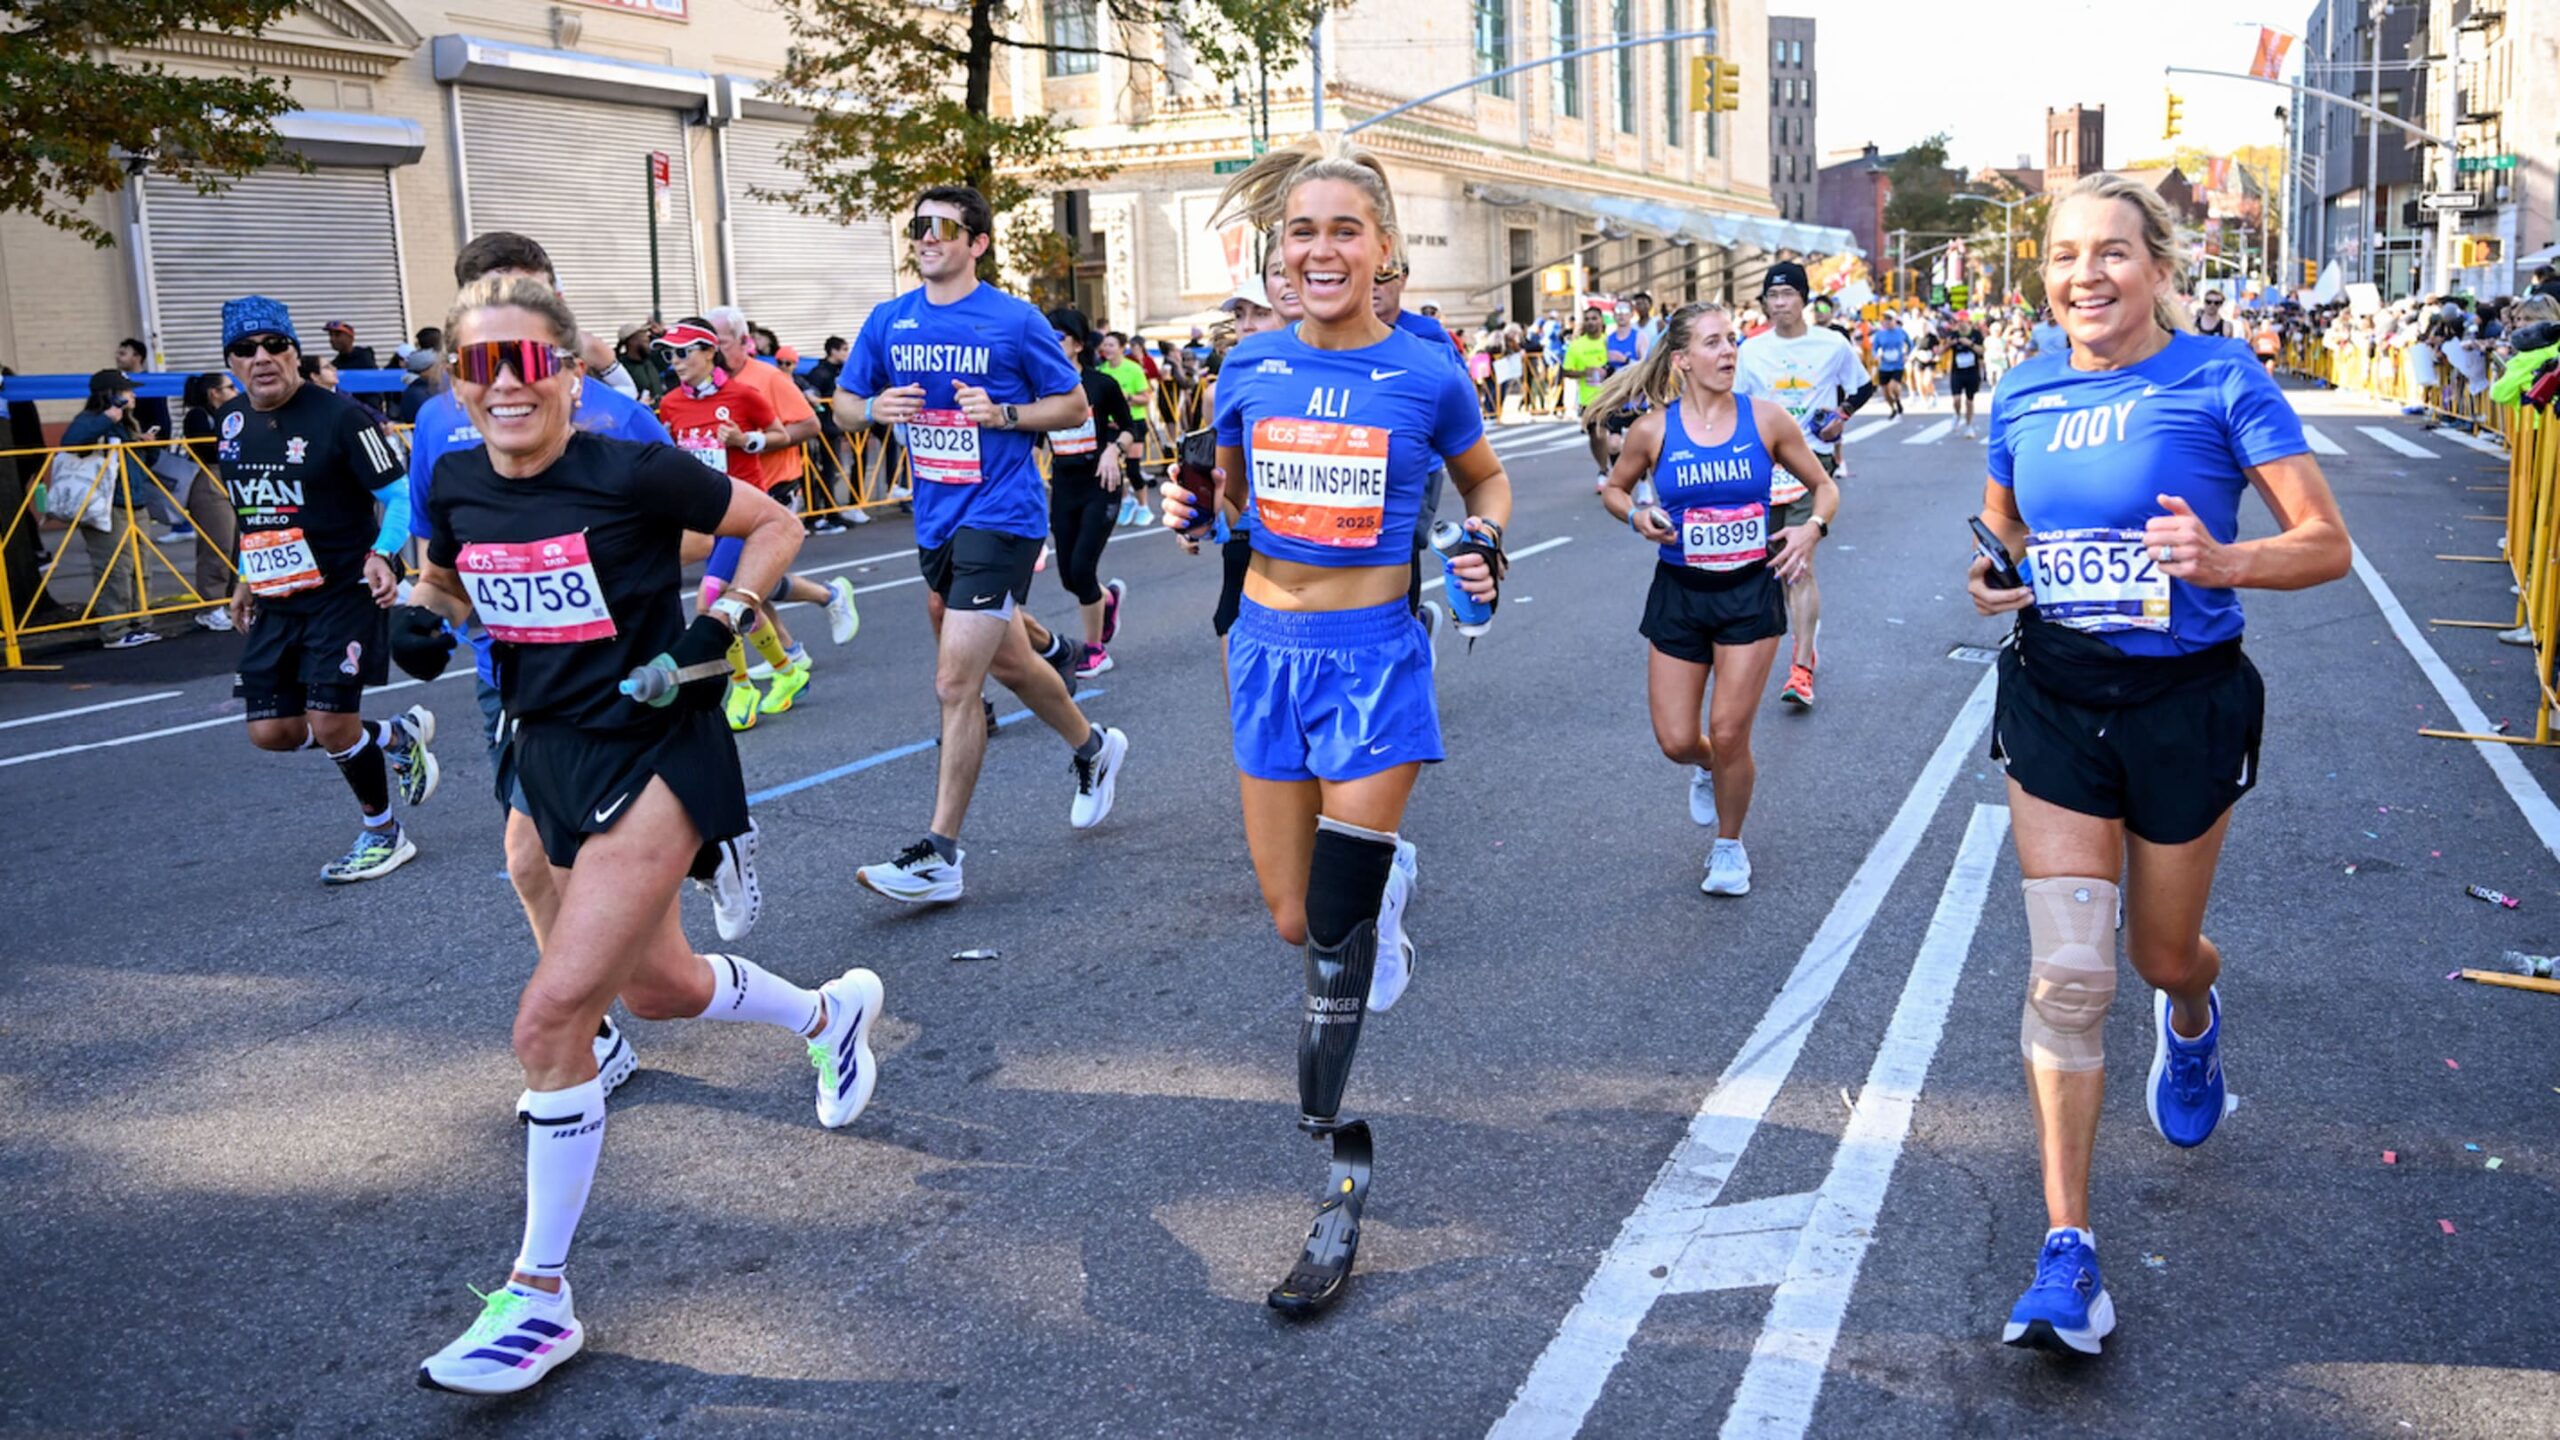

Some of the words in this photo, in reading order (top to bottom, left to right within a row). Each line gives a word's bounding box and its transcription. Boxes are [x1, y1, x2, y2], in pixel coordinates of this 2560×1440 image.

[890, 344, 990, 374] CHRISTIAN
[1306, 386, 1350, 418] ALI
[911, 426, 974, 452] 33028
[1267, 424, 1296, 444] tcs
[2047, 400, 2136, 452] JODY
[1256, 460, 1303, 492] TEAM
[1310, 466, 1382, 496] INSPIRE
[1676, 458, 1752, 488] HANNAH
[1336, 516, 1376, 529] 2025
[1690, 519, 1758, 546] 61899
[246, 544, 303, 573] 12185
[467, 551, 494, 570] tcs
[2037, 546, 2158, 587] 56652
[477, 571, 592, 612] 43758
